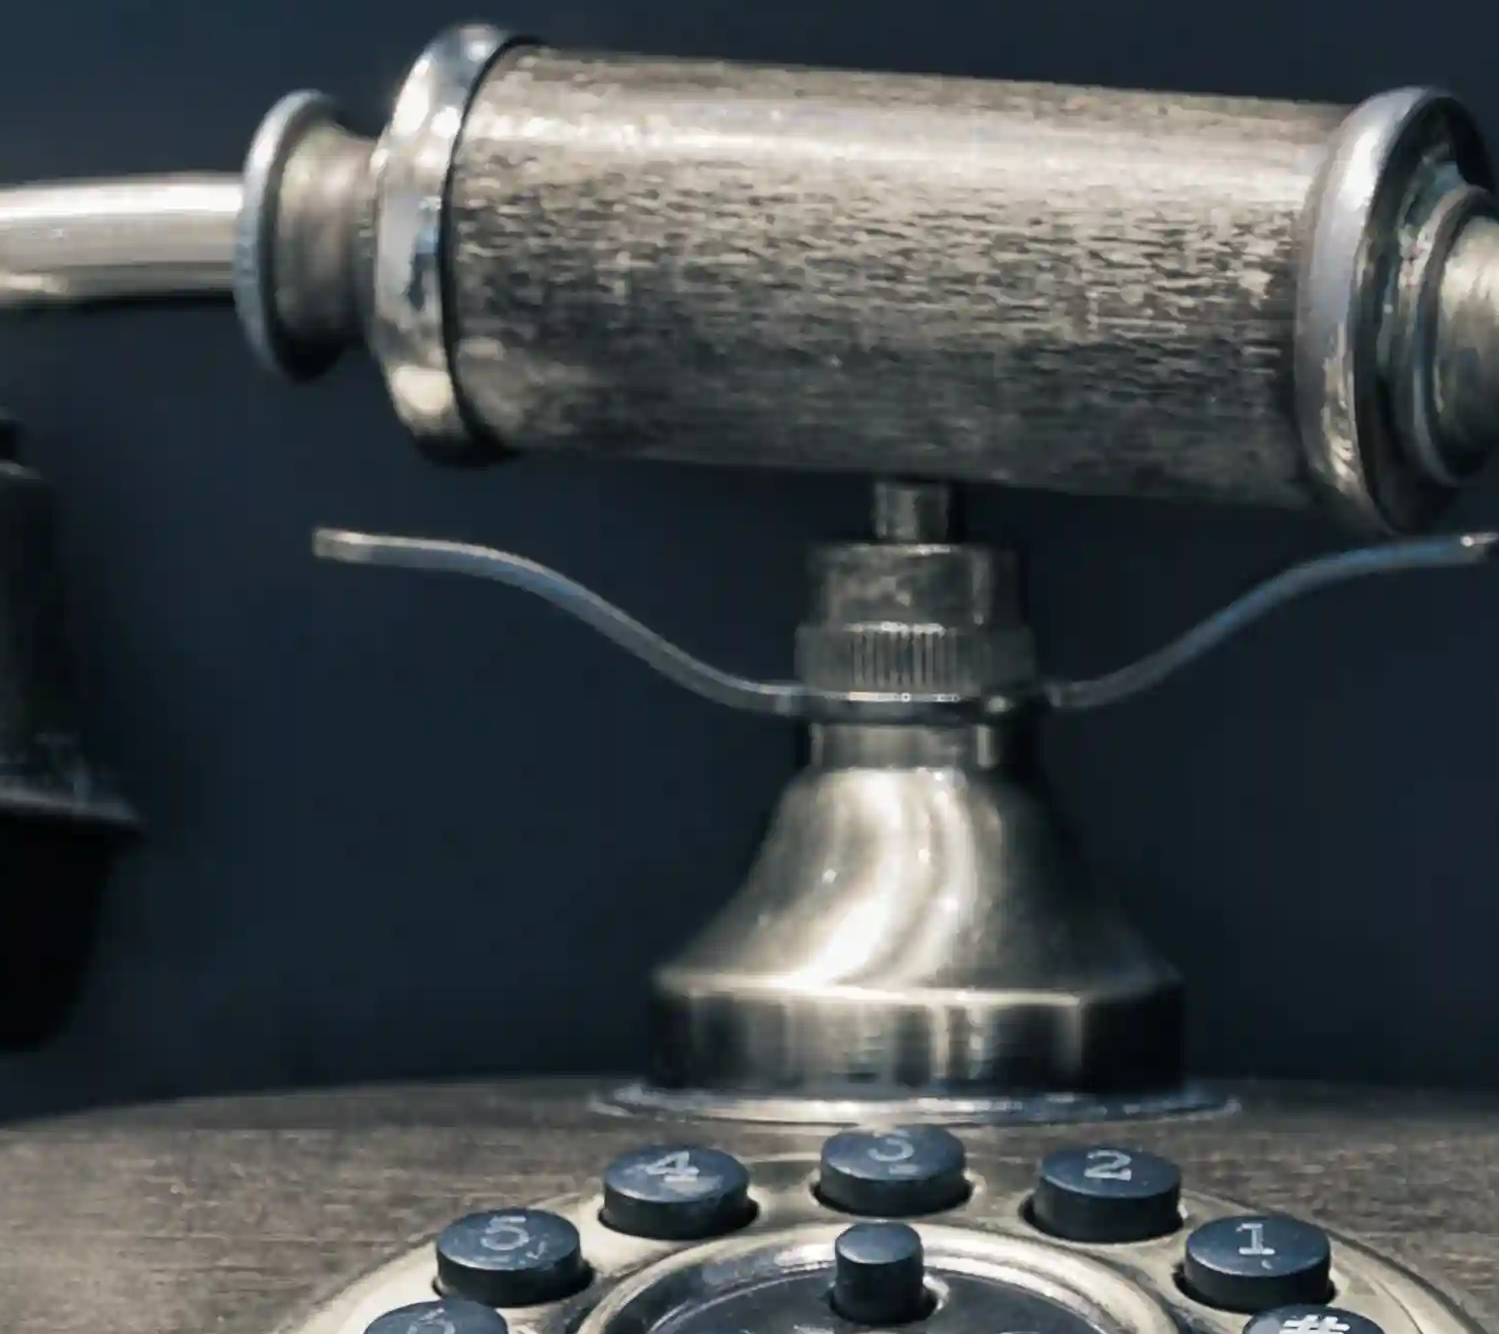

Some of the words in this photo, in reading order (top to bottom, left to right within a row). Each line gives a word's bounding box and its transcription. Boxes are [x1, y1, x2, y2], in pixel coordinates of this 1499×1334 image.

[645, 1151, 700, 1183] 4
[1084, 1149, 1132, 1181] 2
[481, 1215, 529, 1251] 5
[1236, 1223, 1275, 1255] 1
